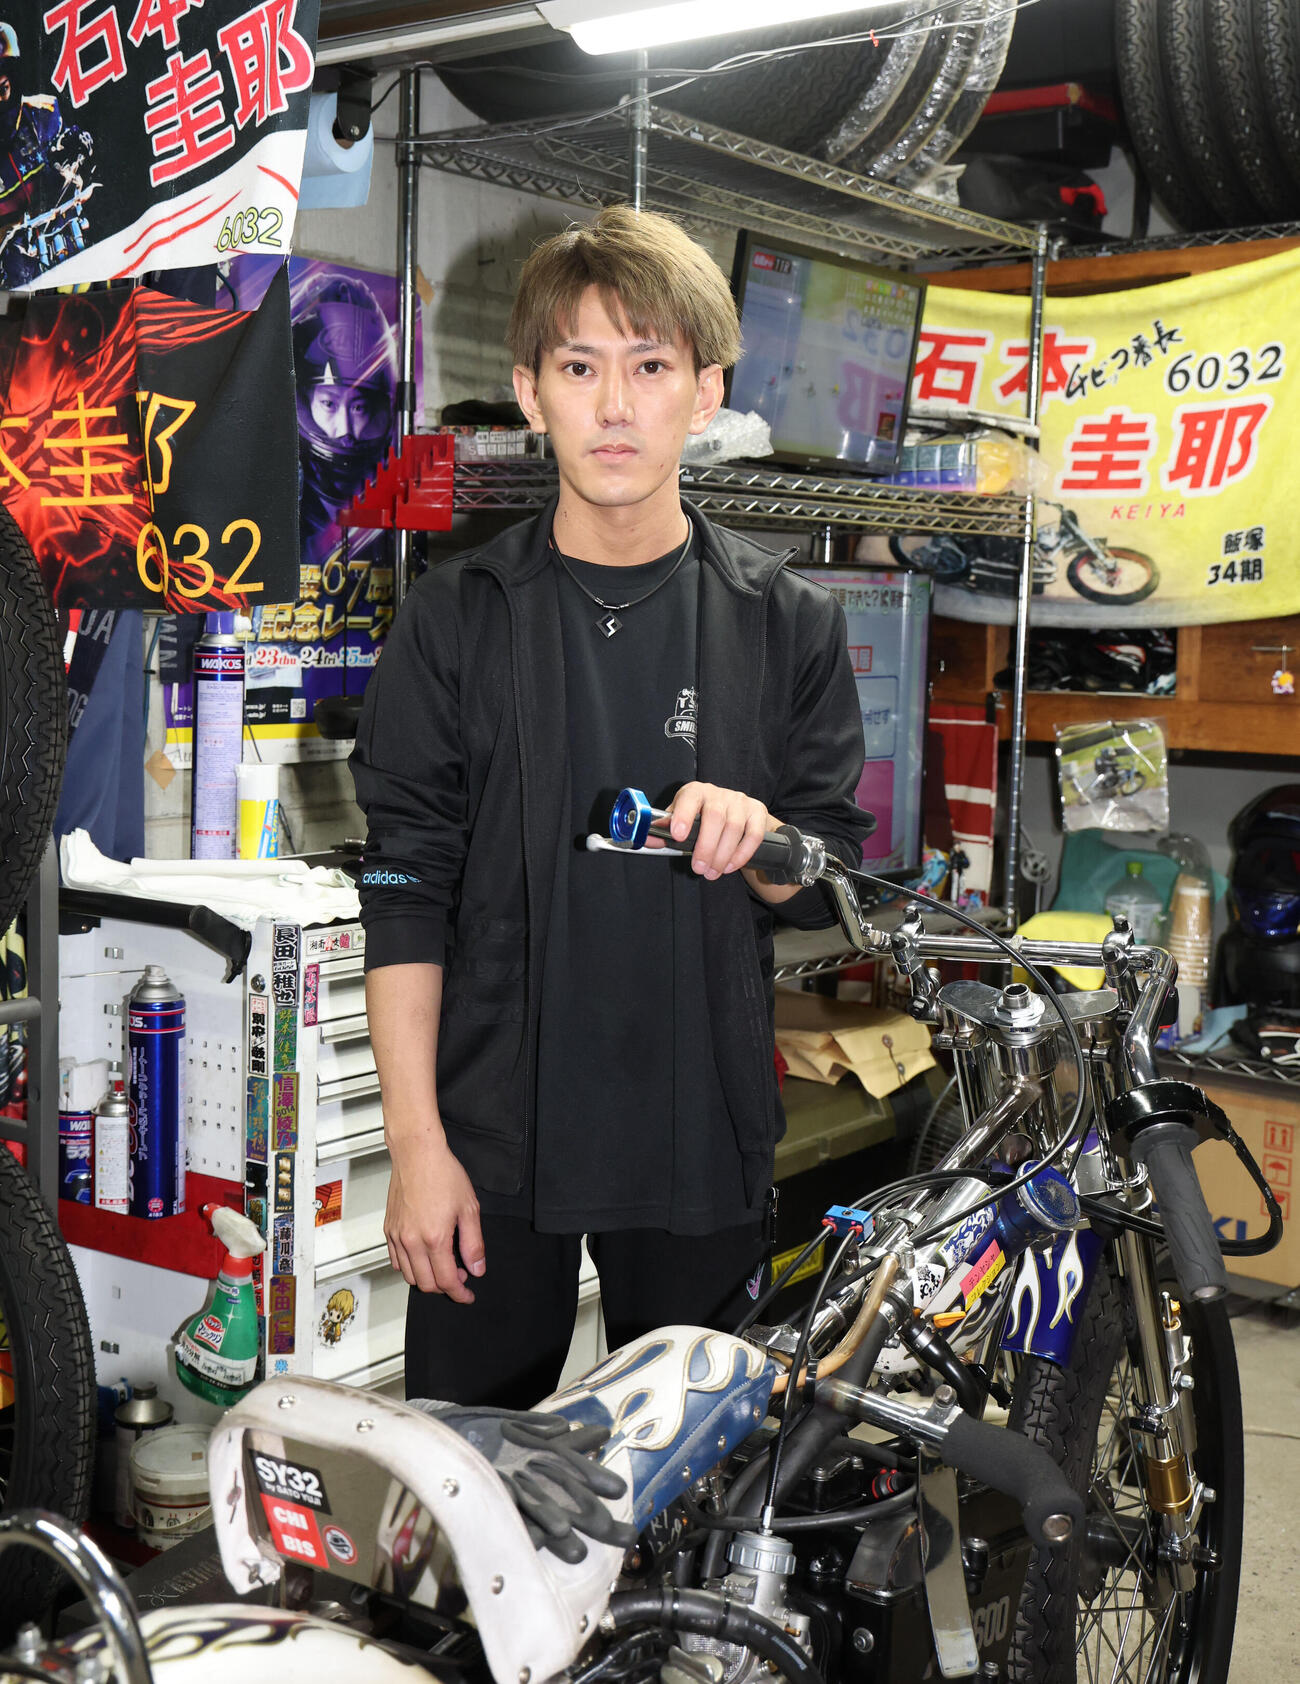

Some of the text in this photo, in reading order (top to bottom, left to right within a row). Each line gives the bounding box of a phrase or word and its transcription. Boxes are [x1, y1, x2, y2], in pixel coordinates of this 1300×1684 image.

[145, 0, 314, 187] 圭耶
[217, 207, 283, 252] 6032
[914, 331, 1088, 404] 石本
[1168, 345, 1283, 392] 6032
[1061, 402, 1267, 490] 圭耶
[1111, 503, 1186, 519] KEIYA
[1223, 527, 1264, 554] 飯塚
[1208, 559, 1263, 585] 34期
[363, 870, 408, 885] adidas
[255, 1457, 323, 1498] SY32
[276, 1485, 300, 1499] SATO
[301, 1492, 321, 1506] YUJI
[273, 1507, 308, 1530] CHI
[281, 1534, 316, 1558] BIS
